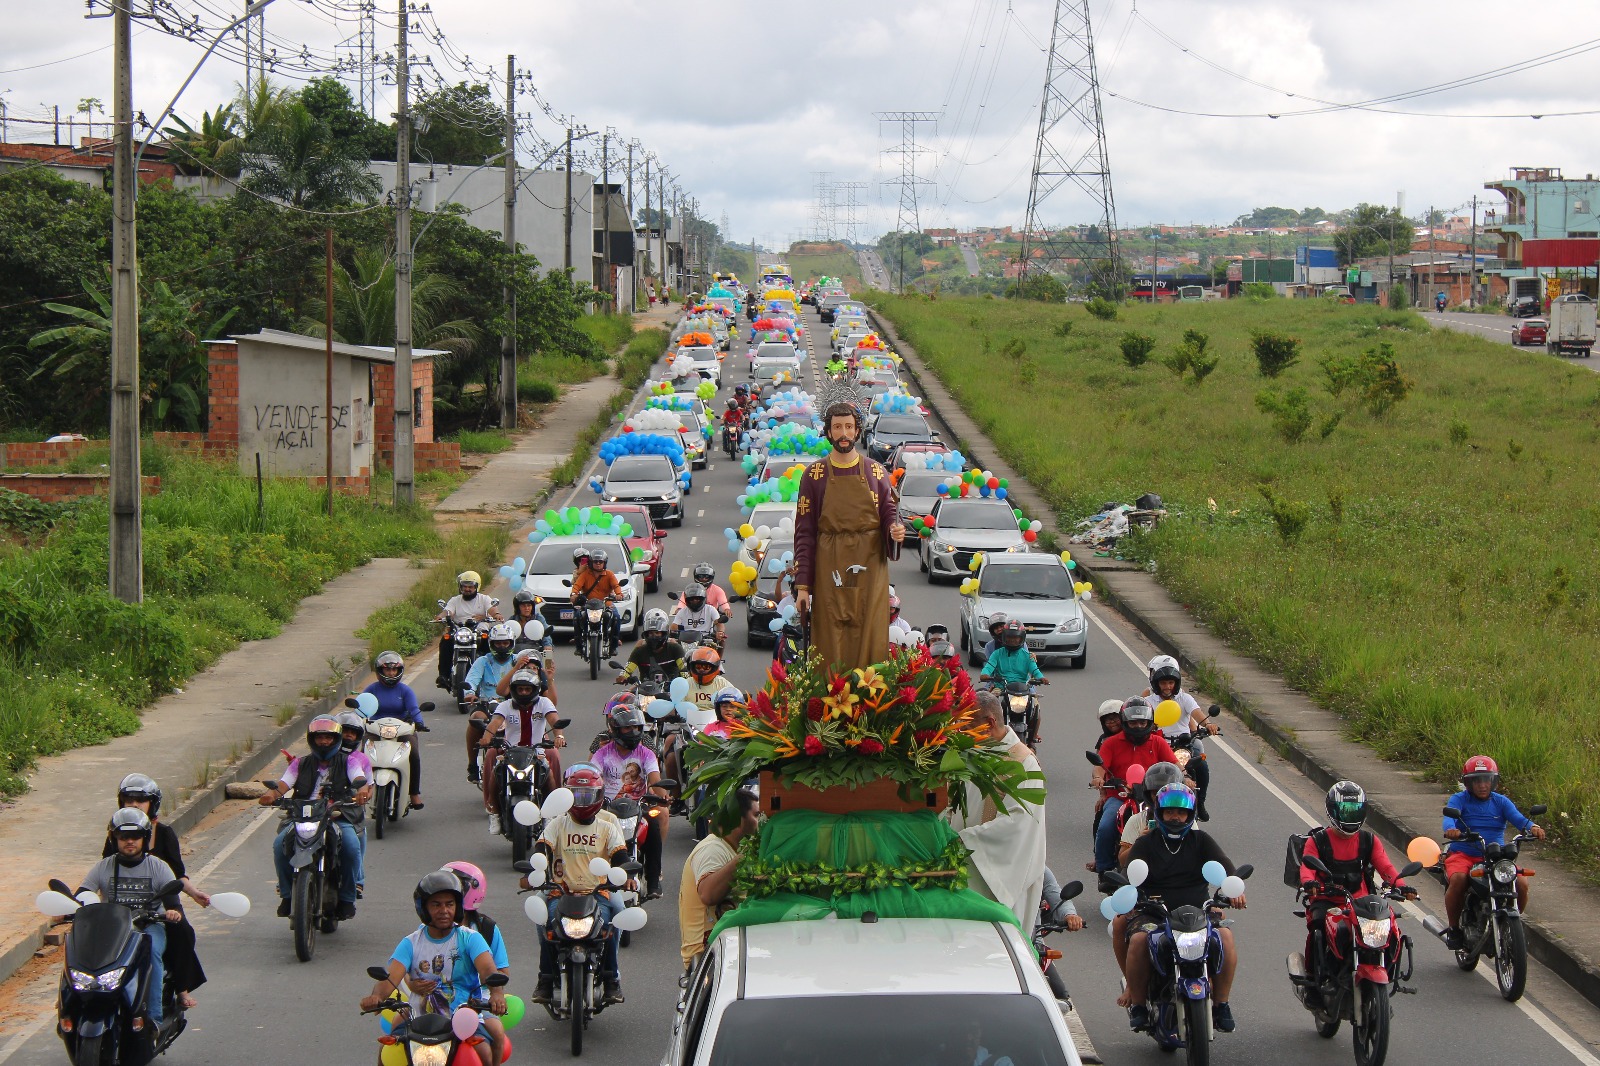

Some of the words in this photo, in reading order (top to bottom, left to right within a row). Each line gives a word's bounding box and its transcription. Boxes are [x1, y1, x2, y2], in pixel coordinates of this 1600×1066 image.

[1140, 280, 1167, 288] Librty
[254, 404, 350, 431] VENDE-SE
[275, 430, 313, 450] AÇAI
[695, 692, 712, 703] JOS
[567, 833, 596, 847] JOSÉ
